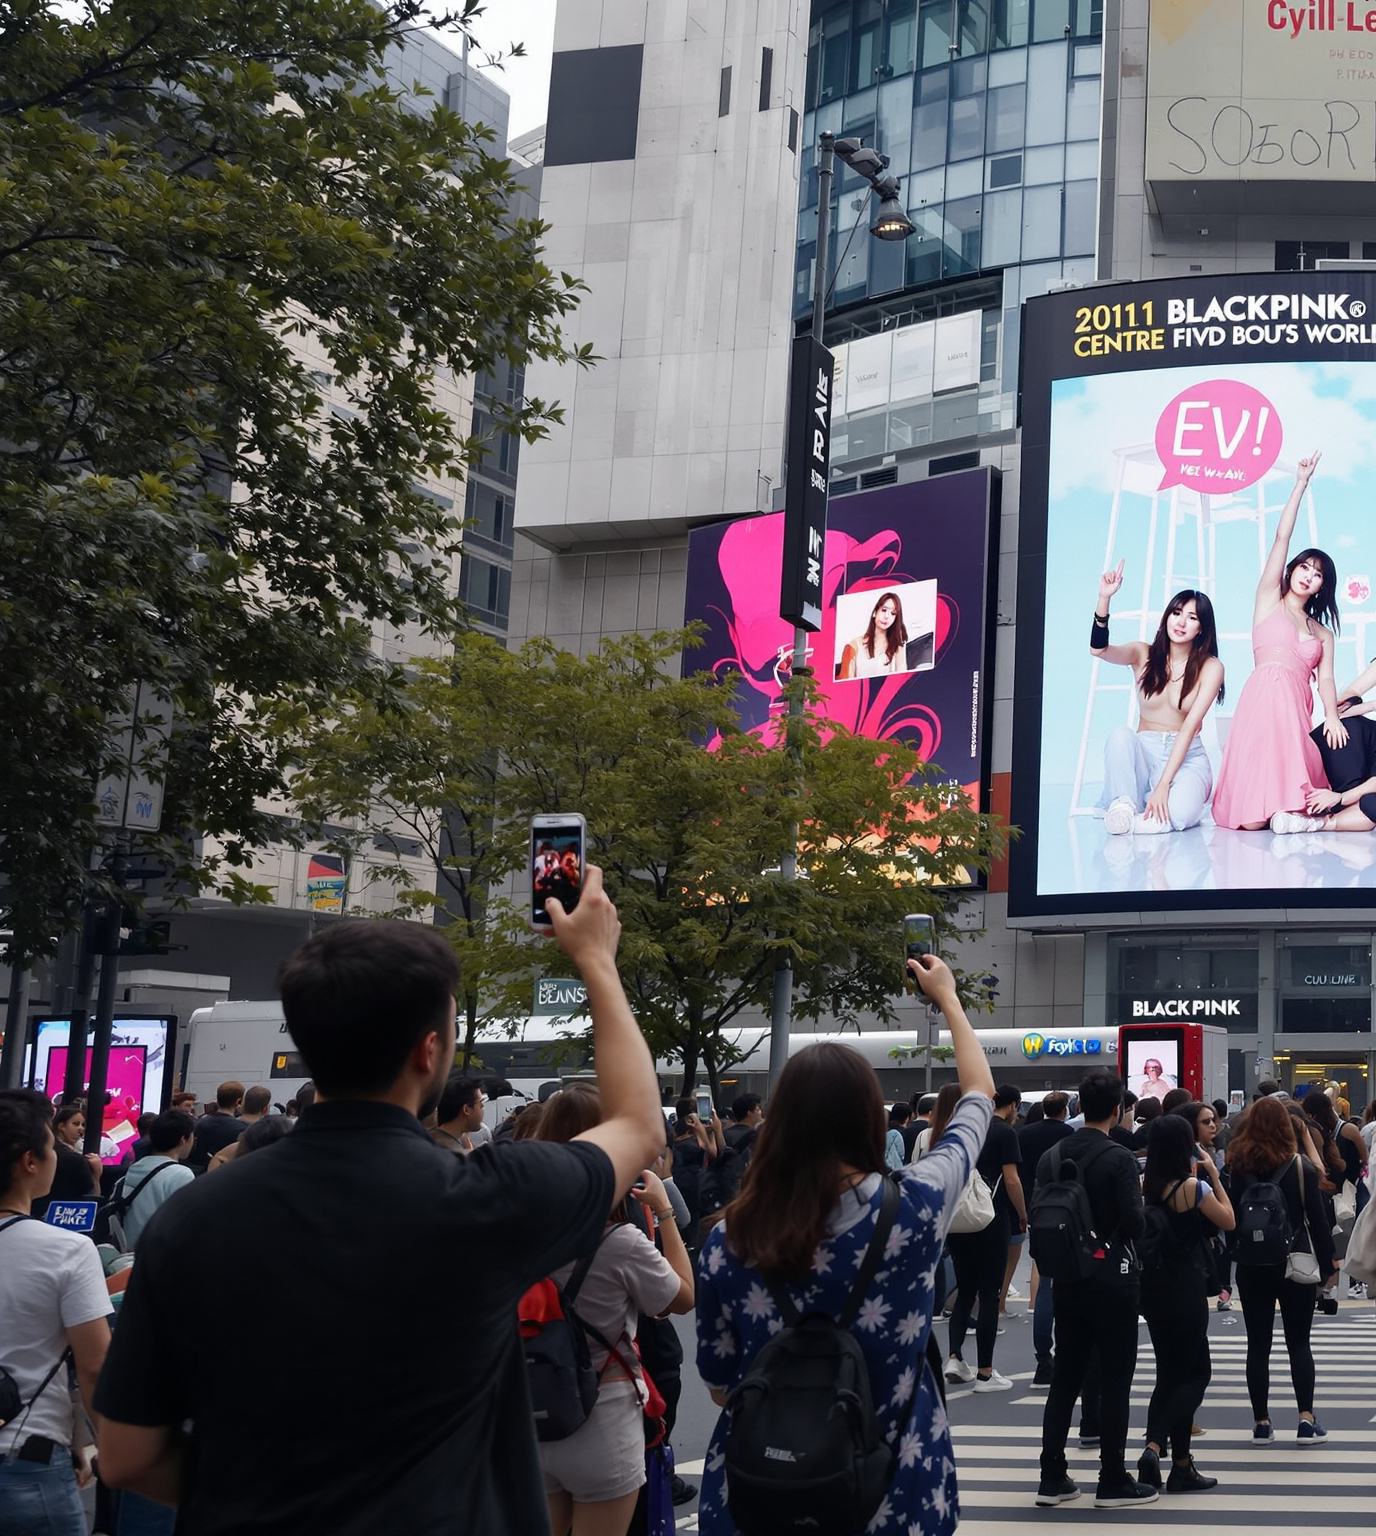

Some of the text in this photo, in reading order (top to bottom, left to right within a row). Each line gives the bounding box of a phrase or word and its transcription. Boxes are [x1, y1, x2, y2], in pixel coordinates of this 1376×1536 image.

[1073, 328, 1165, 358] CENTRE
[1172, 400, 1270, 460] EV!
[1132, 998, 1241, 1017] BLACKPINK
